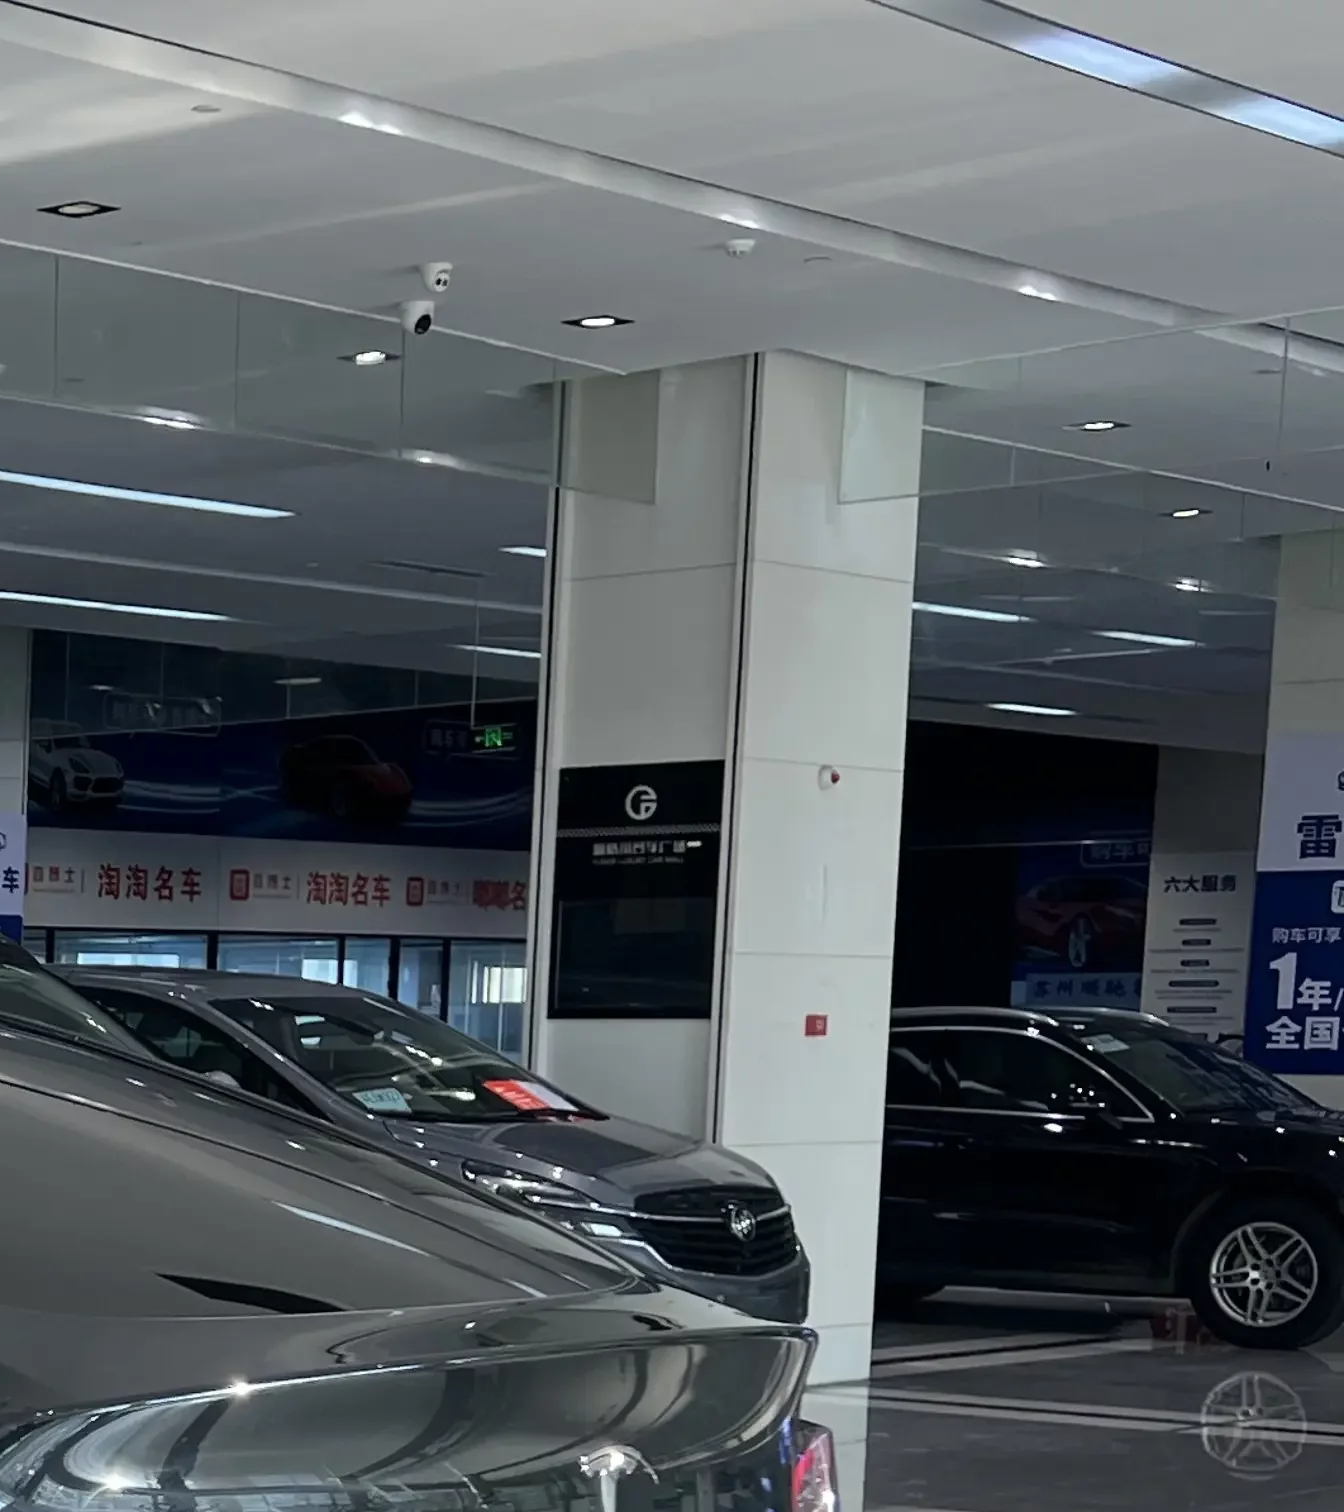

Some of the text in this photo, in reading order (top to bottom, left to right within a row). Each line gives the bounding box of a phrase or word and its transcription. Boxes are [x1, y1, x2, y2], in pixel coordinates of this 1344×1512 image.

[1297, 815, 1342, 859] 雷
[97, 863, 202, 903] 淘淘名车
[306, 871, 391, 908] 淘淘名车
[1164, 874, 1237, 893] 六大服务
[1265, 1015, 1344, 1051] 全国
